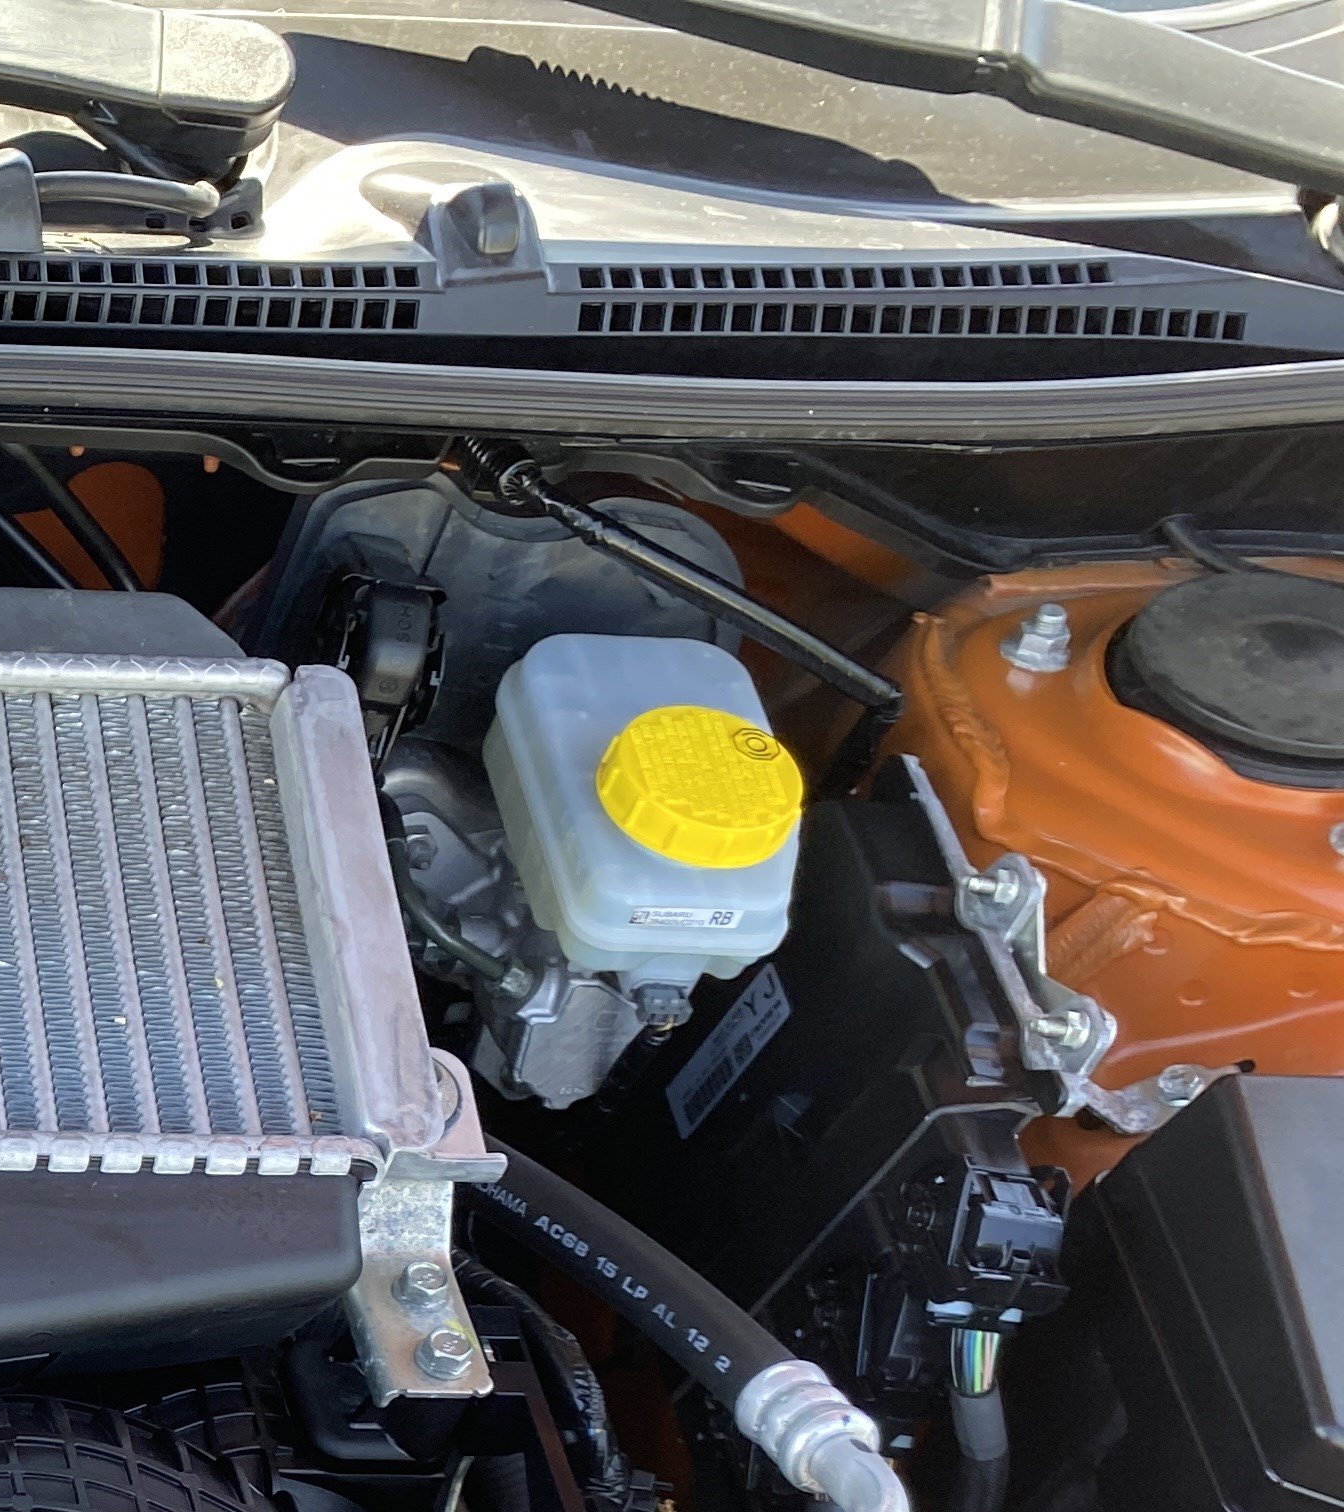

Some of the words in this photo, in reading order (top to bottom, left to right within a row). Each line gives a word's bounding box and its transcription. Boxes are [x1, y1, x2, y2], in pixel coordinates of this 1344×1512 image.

[708, 911, 734, 926] RB
[473, 1183, 528, 1218] OHAMA
[595, 1256, 619, 1279] 15
[622, 1276, 649, 1300] LP
[651, 1303, 677, 1329] AL
[687, 1328, 711, 1353] 12
[714, 1355, 732, 1374] 2
